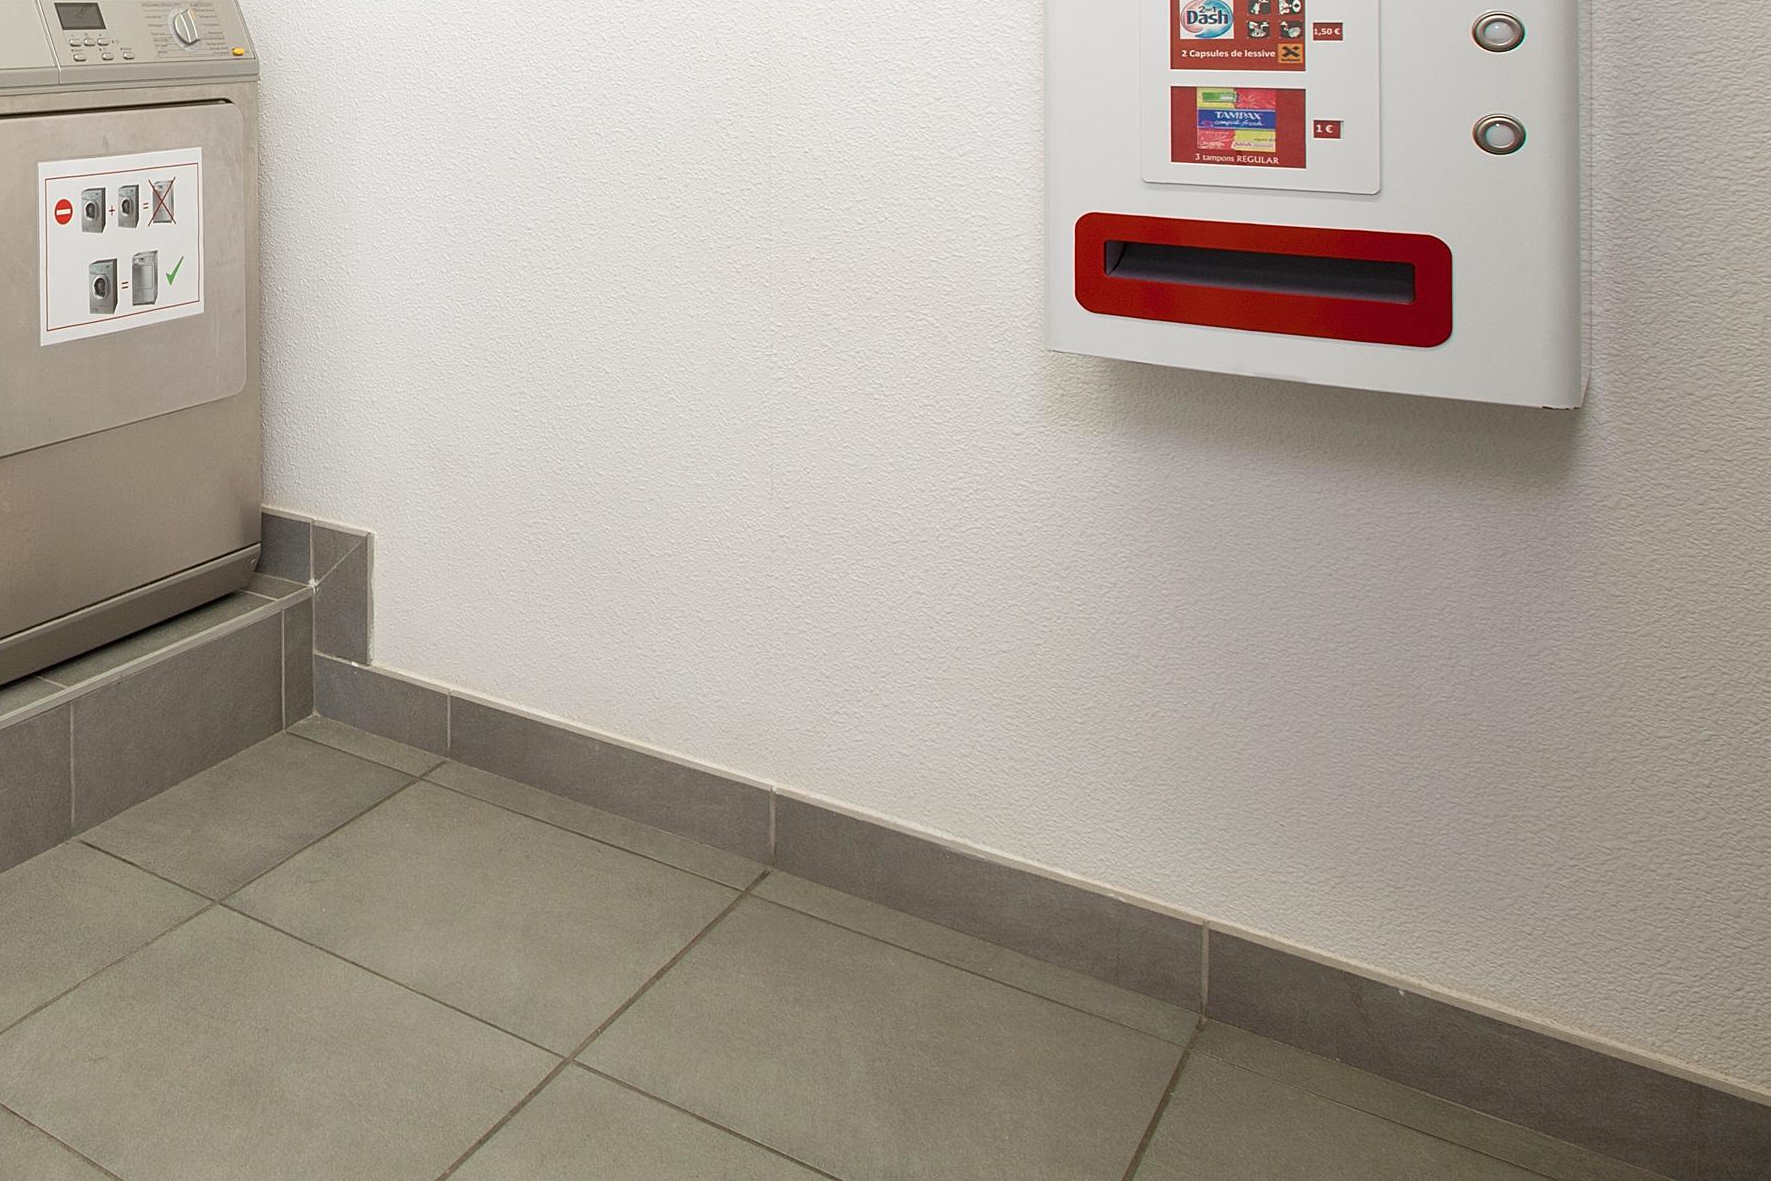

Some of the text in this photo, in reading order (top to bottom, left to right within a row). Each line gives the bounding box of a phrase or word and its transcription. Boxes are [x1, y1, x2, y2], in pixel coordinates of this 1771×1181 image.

[1186, 7, 1228, 24] Dash
[1181, 49, 1276, 58] 2 Capsules de lessive
[1216, 111, 1261, 120] TAMPAX
[1195, 152, 1279, 164] 3 tampons REGULAR
